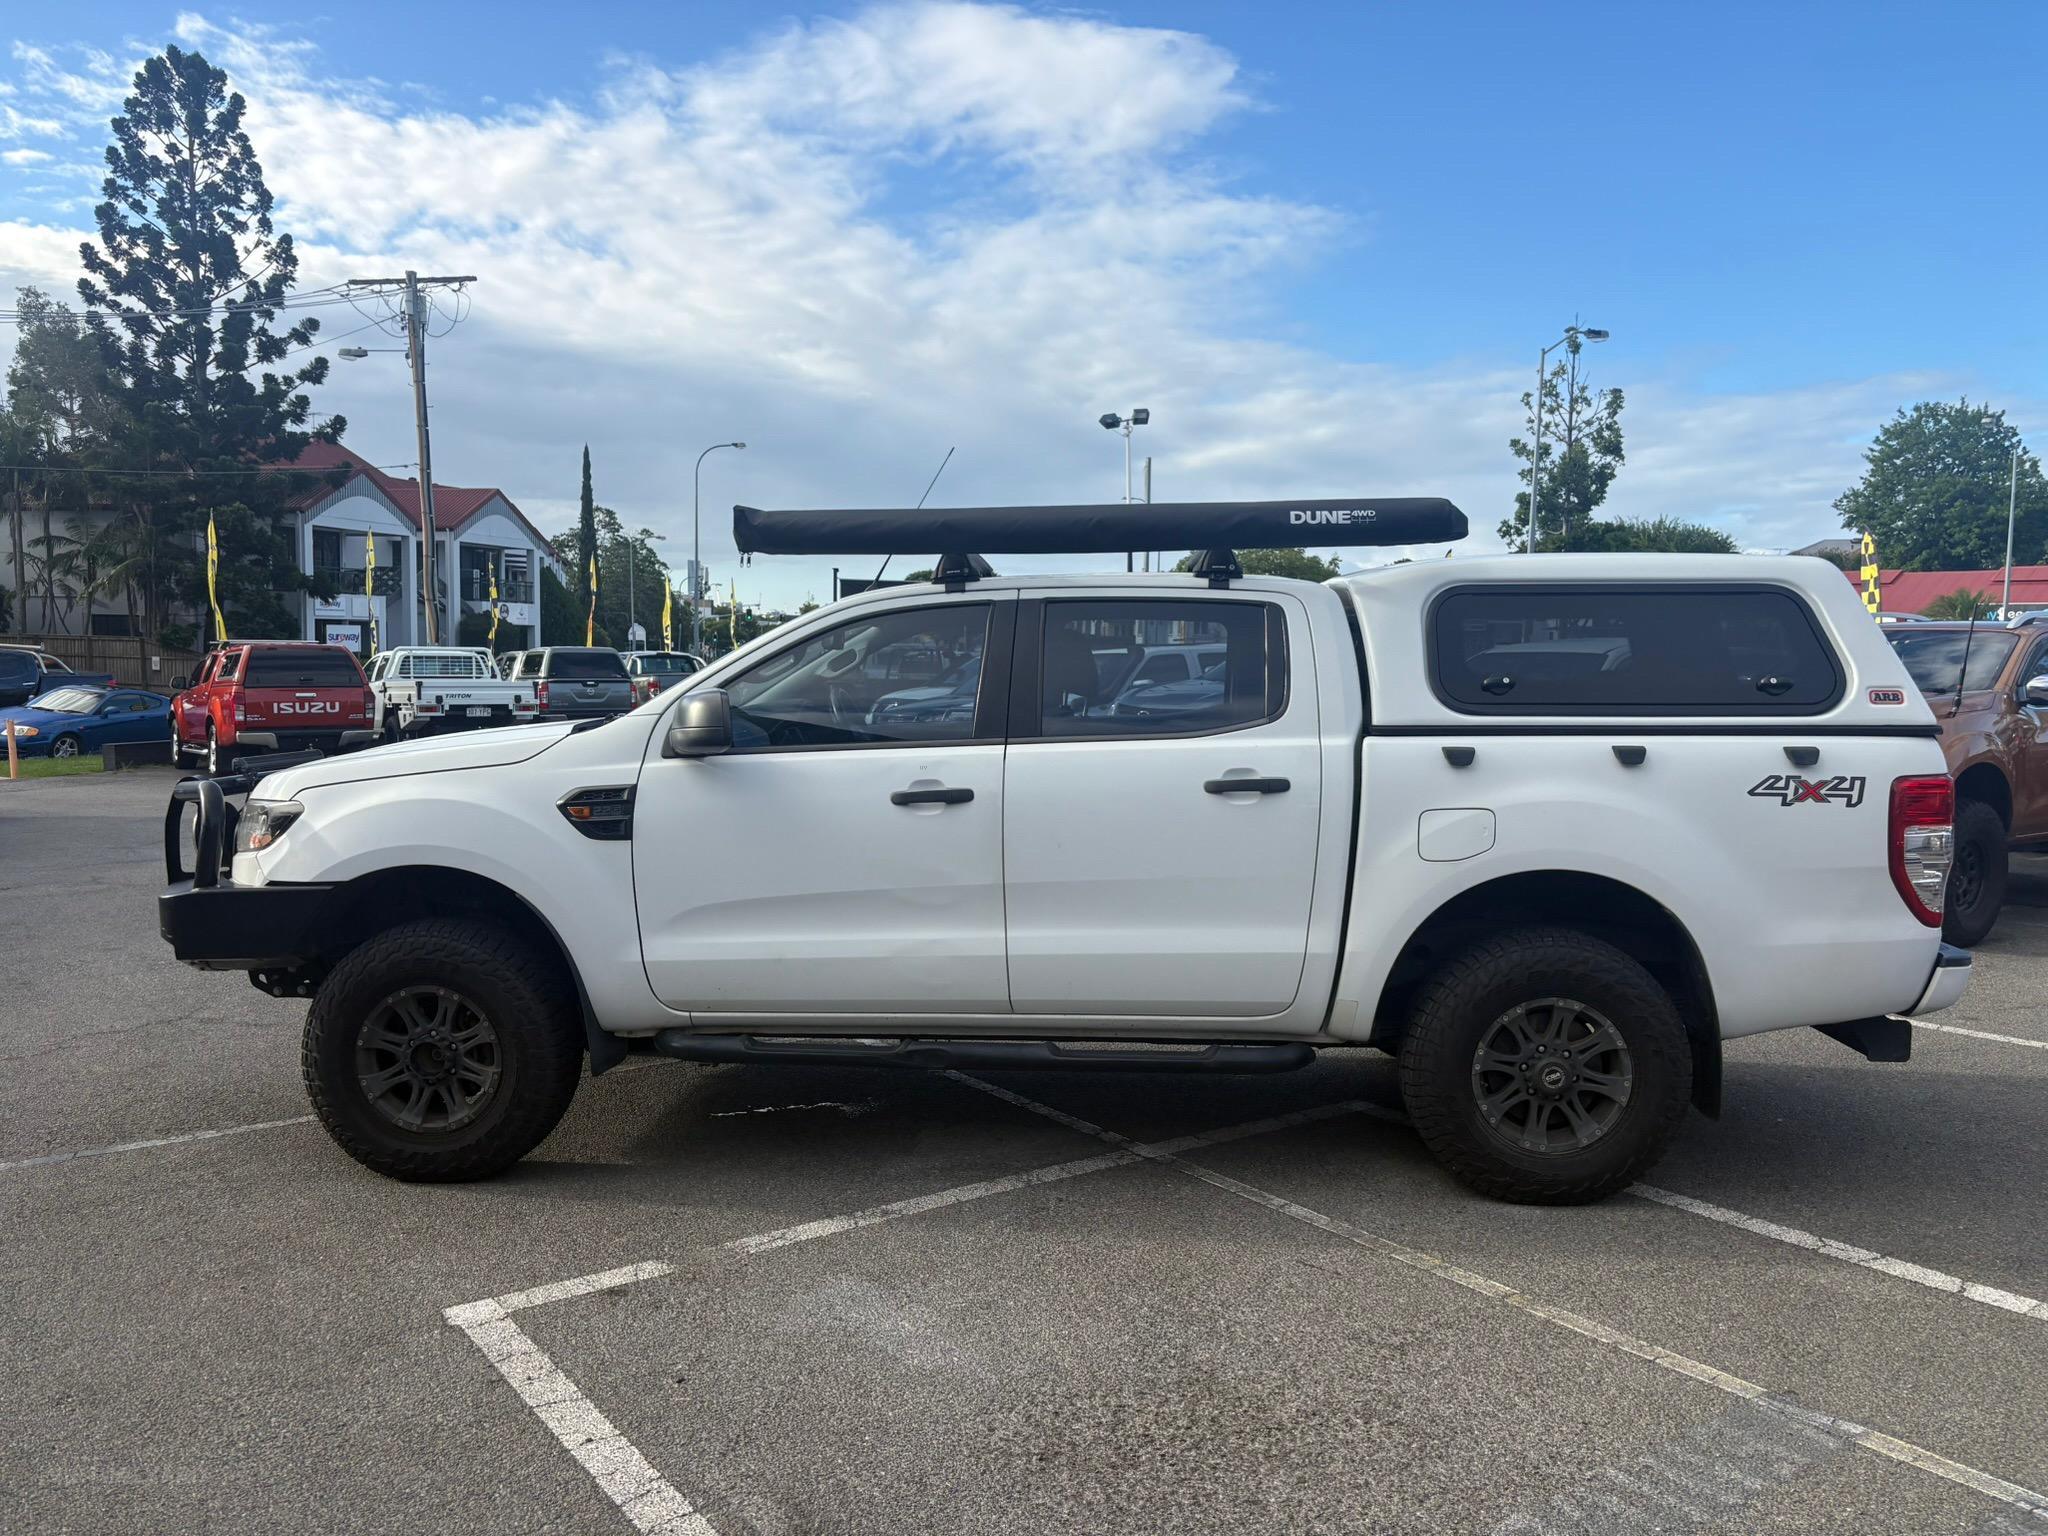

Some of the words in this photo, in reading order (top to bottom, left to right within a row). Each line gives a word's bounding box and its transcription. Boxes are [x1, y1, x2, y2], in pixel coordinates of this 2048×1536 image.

[1290, 511, 1351, 524] DUNE
[1872, 692, 1902, 702] ARB
[272, 701, 340, 714] ISUZU
